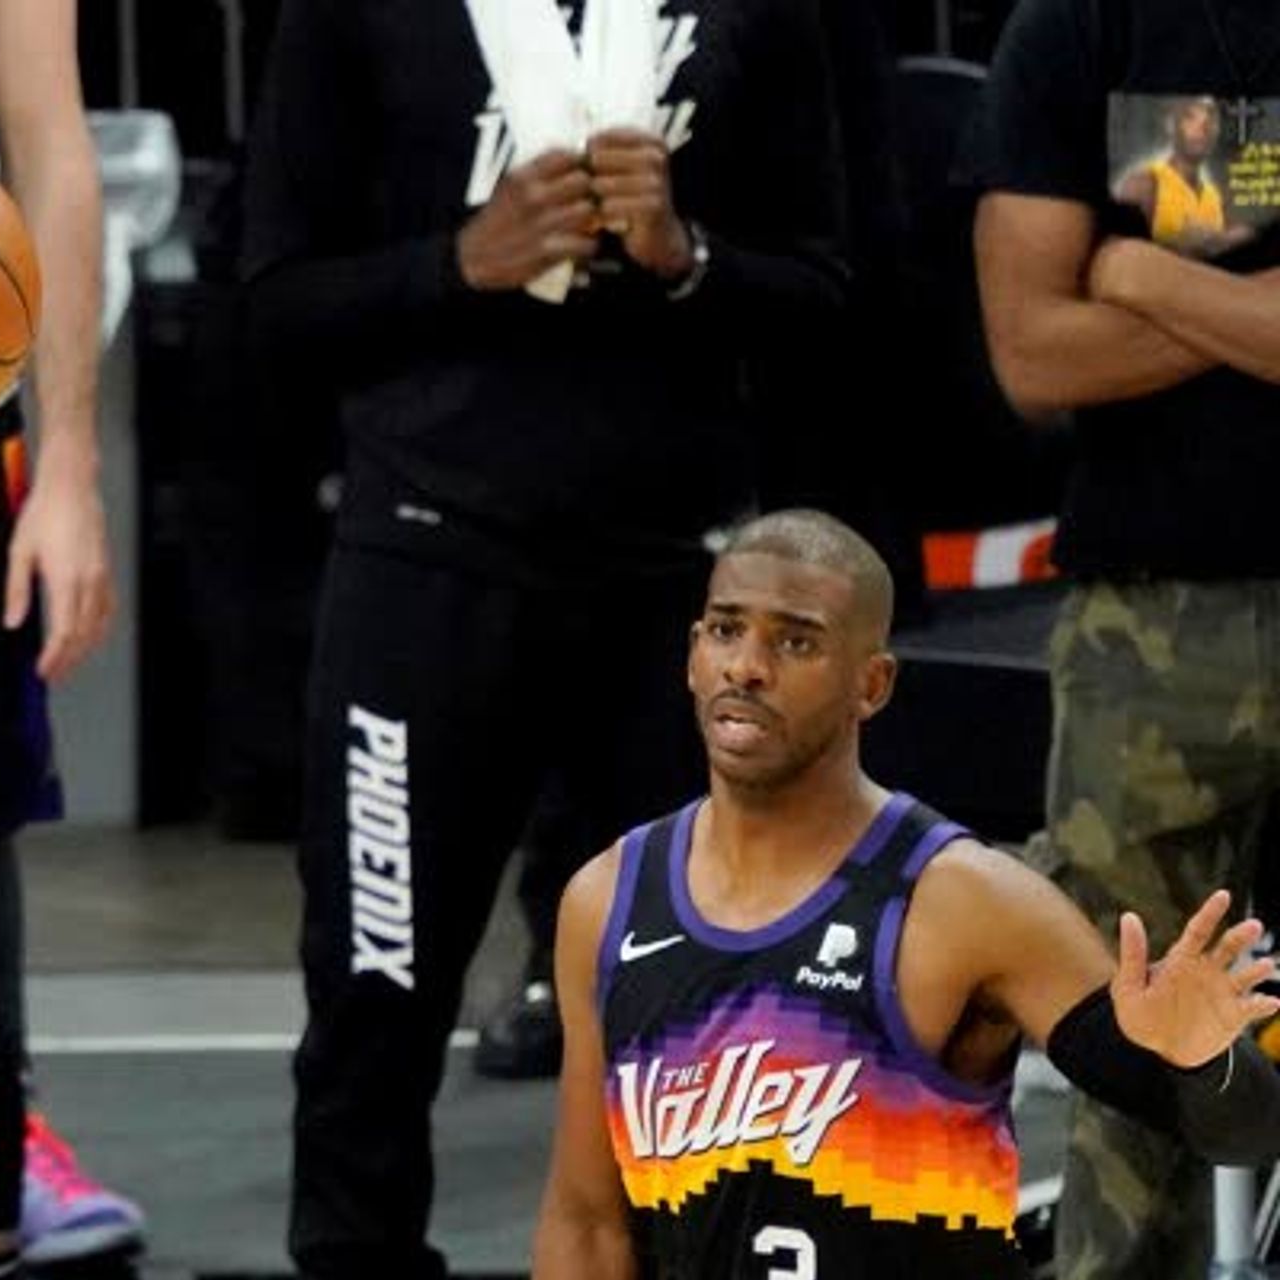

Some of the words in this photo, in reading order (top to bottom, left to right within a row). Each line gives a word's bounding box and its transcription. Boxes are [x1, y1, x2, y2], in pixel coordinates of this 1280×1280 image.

[346, 704, 415, 991] PHOENIX
[796, 966, 863, 992] PayPal
[617, 1038, 862, 1167] Valley
[663, 1062, 710, 1091] THE
